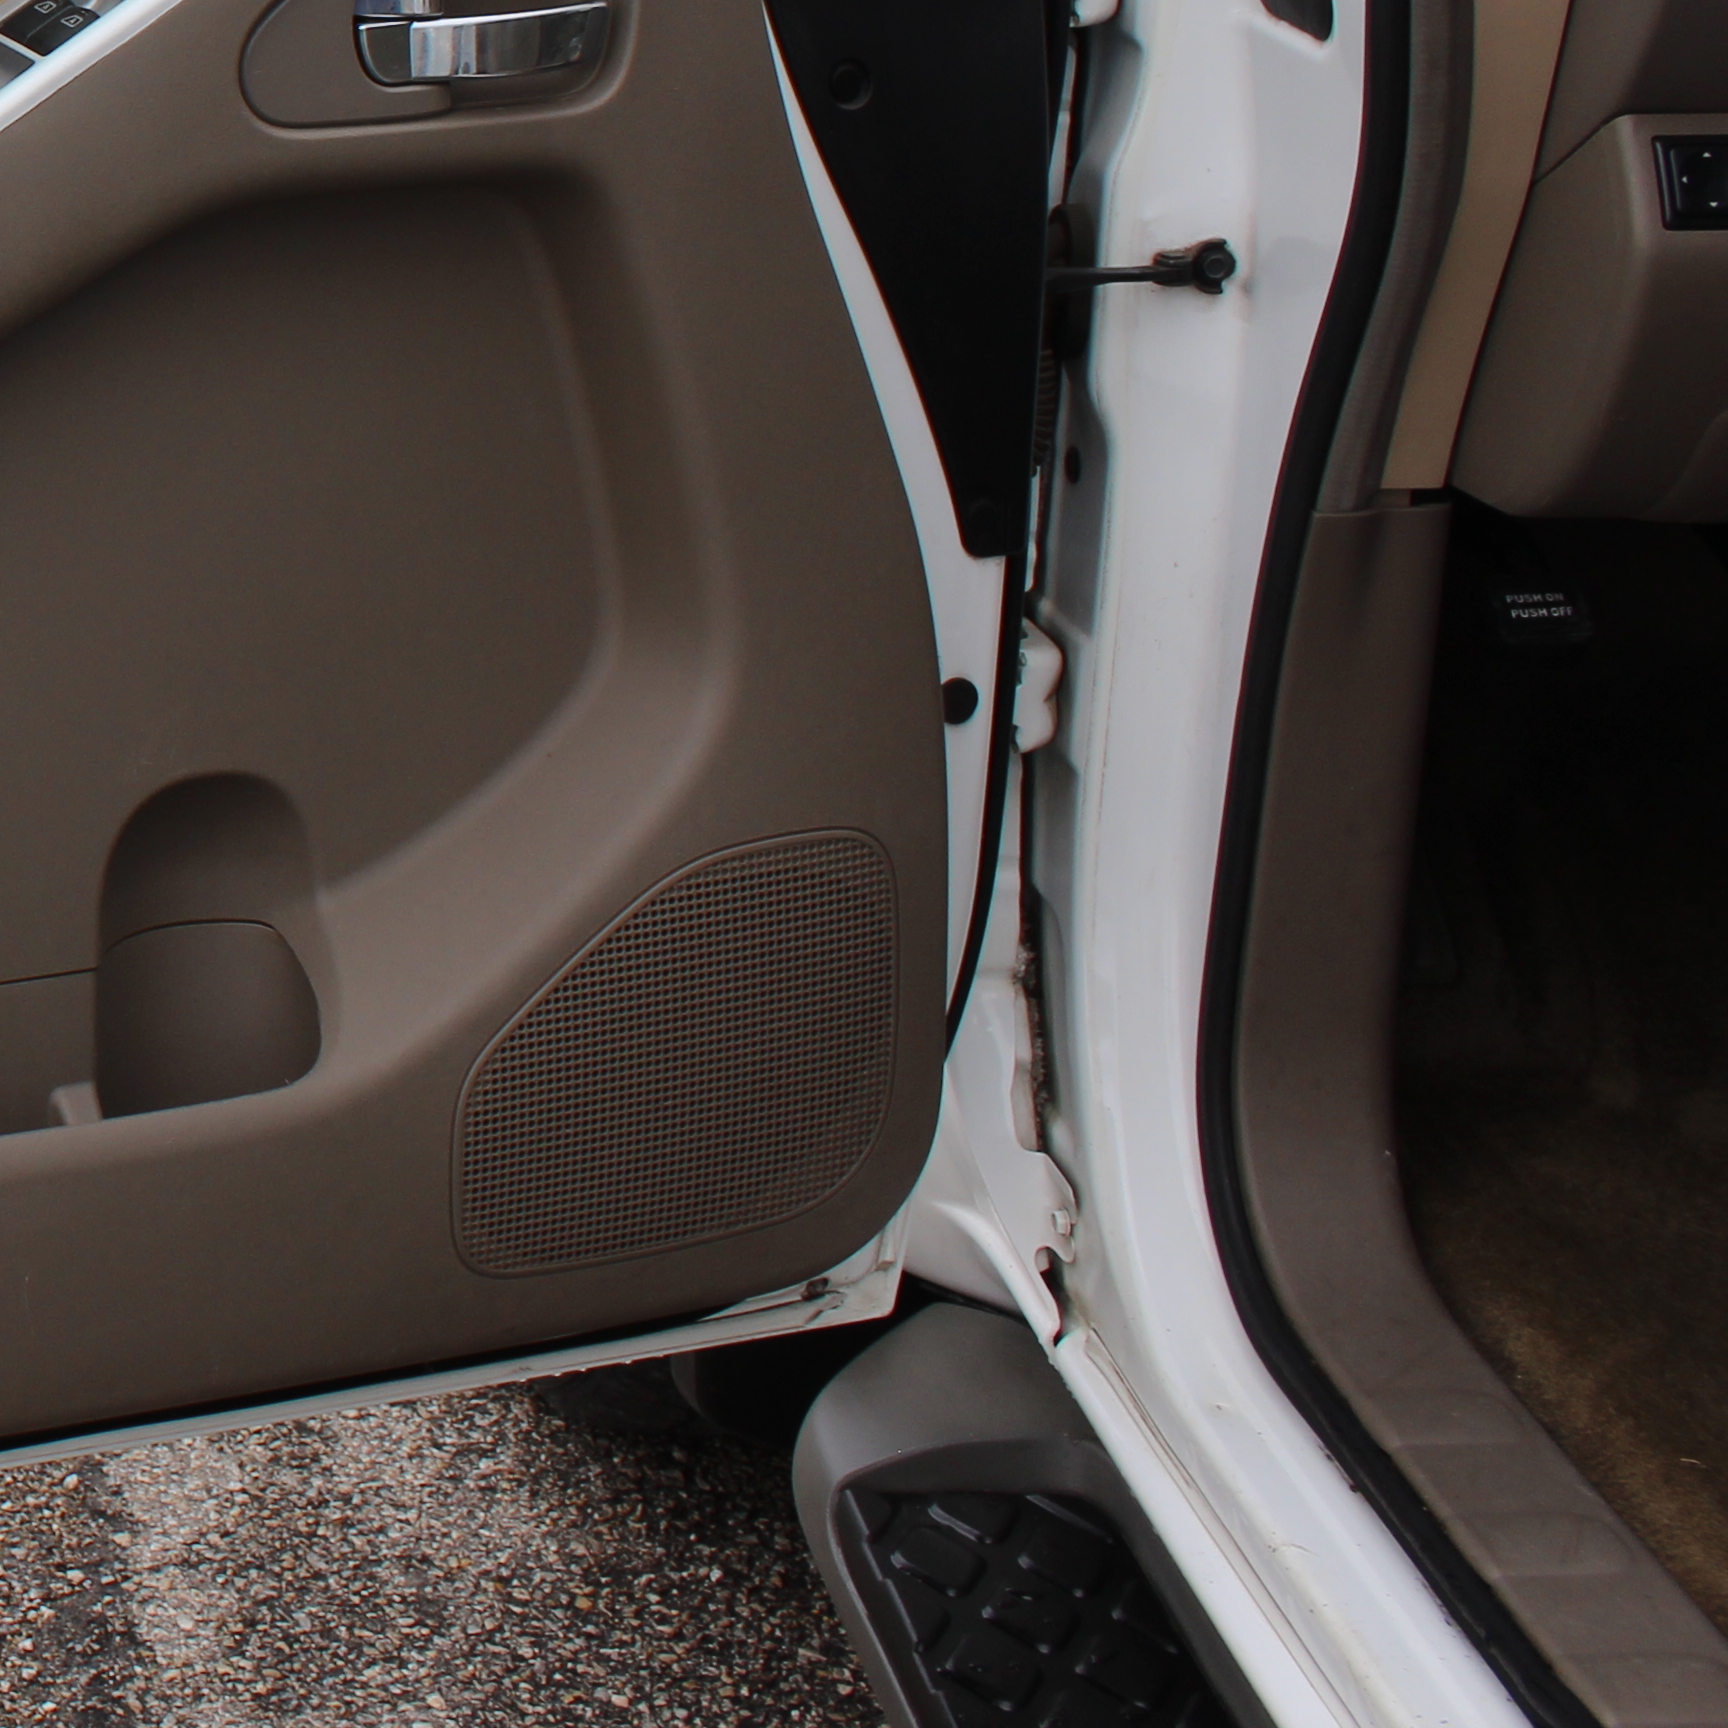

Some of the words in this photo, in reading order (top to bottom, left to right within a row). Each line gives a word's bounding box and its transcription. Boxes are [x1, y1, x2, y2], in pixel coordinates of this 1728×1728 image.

[1505, 593, 1544, 603] PUSH
[1545, 592, 1564, 602] ON
[1510, 607, 1549, 619] PUSH
[1550, 606, 1573, 616] OFF
